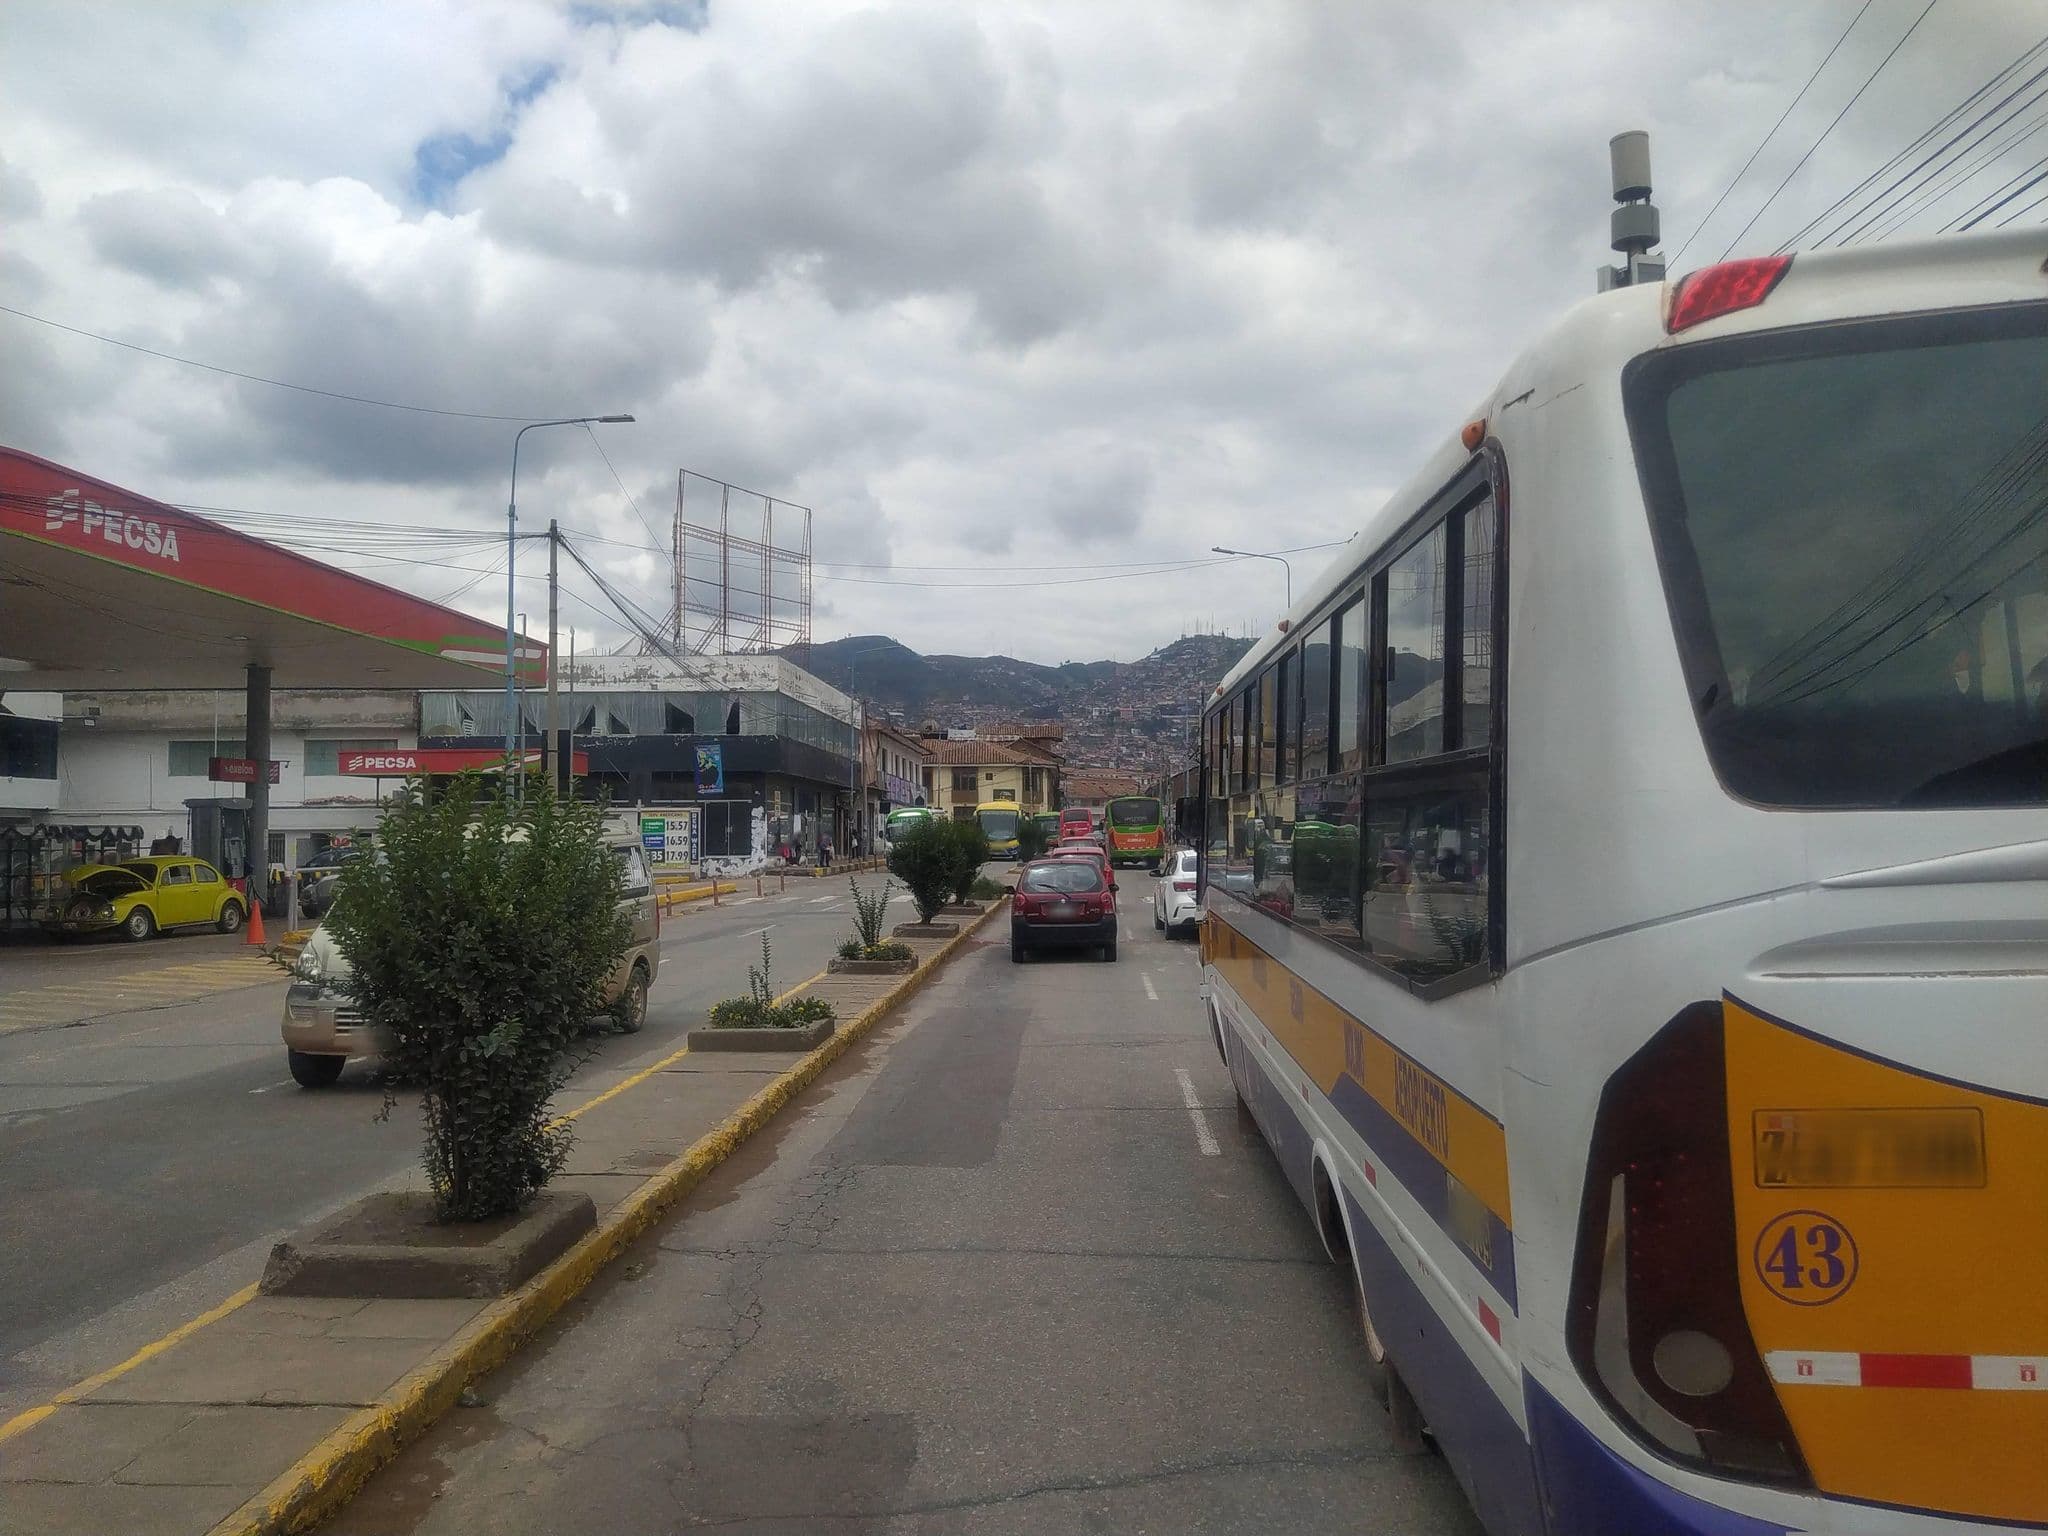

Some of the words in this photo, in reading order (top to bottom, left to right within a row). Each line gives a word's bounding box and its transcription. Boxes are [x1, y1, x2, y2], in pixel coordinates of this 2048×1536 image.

[82, 498, 180, 562] PECSA
[364, 757, 417, 769] PECSA
[1393, 1053, 1449, 1160] AEROPUERTO
[1764, 1224, 1846, 1289] 43
